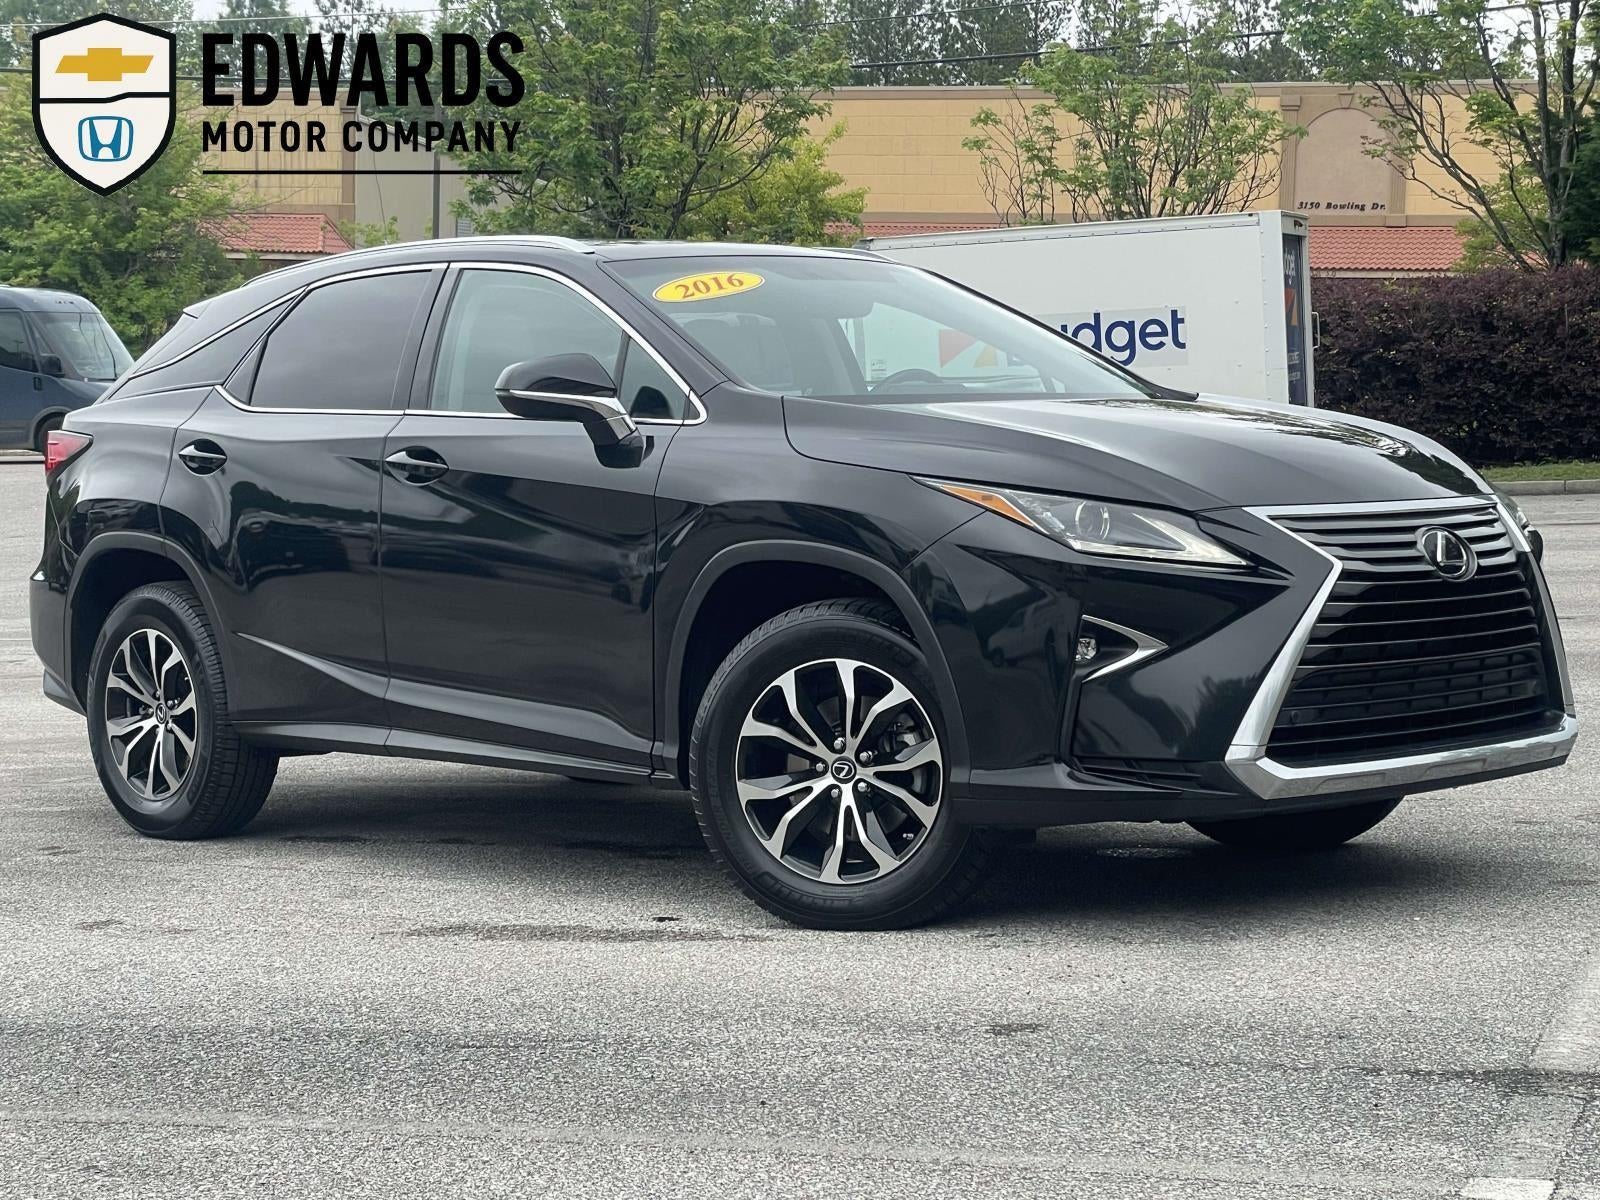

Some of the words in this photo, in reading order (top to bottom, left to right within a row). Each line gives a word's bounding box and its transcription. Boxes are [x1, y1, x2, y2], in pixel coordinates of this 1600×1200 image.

[1298, 201, 1321, 210] 3150
[1325, 201, 1366, 212] Bowling
[1371, 202, 1387, 210] Dr.
[674, 273, 744, 299] 2016
[1060, 309, 1187, 367] dget
